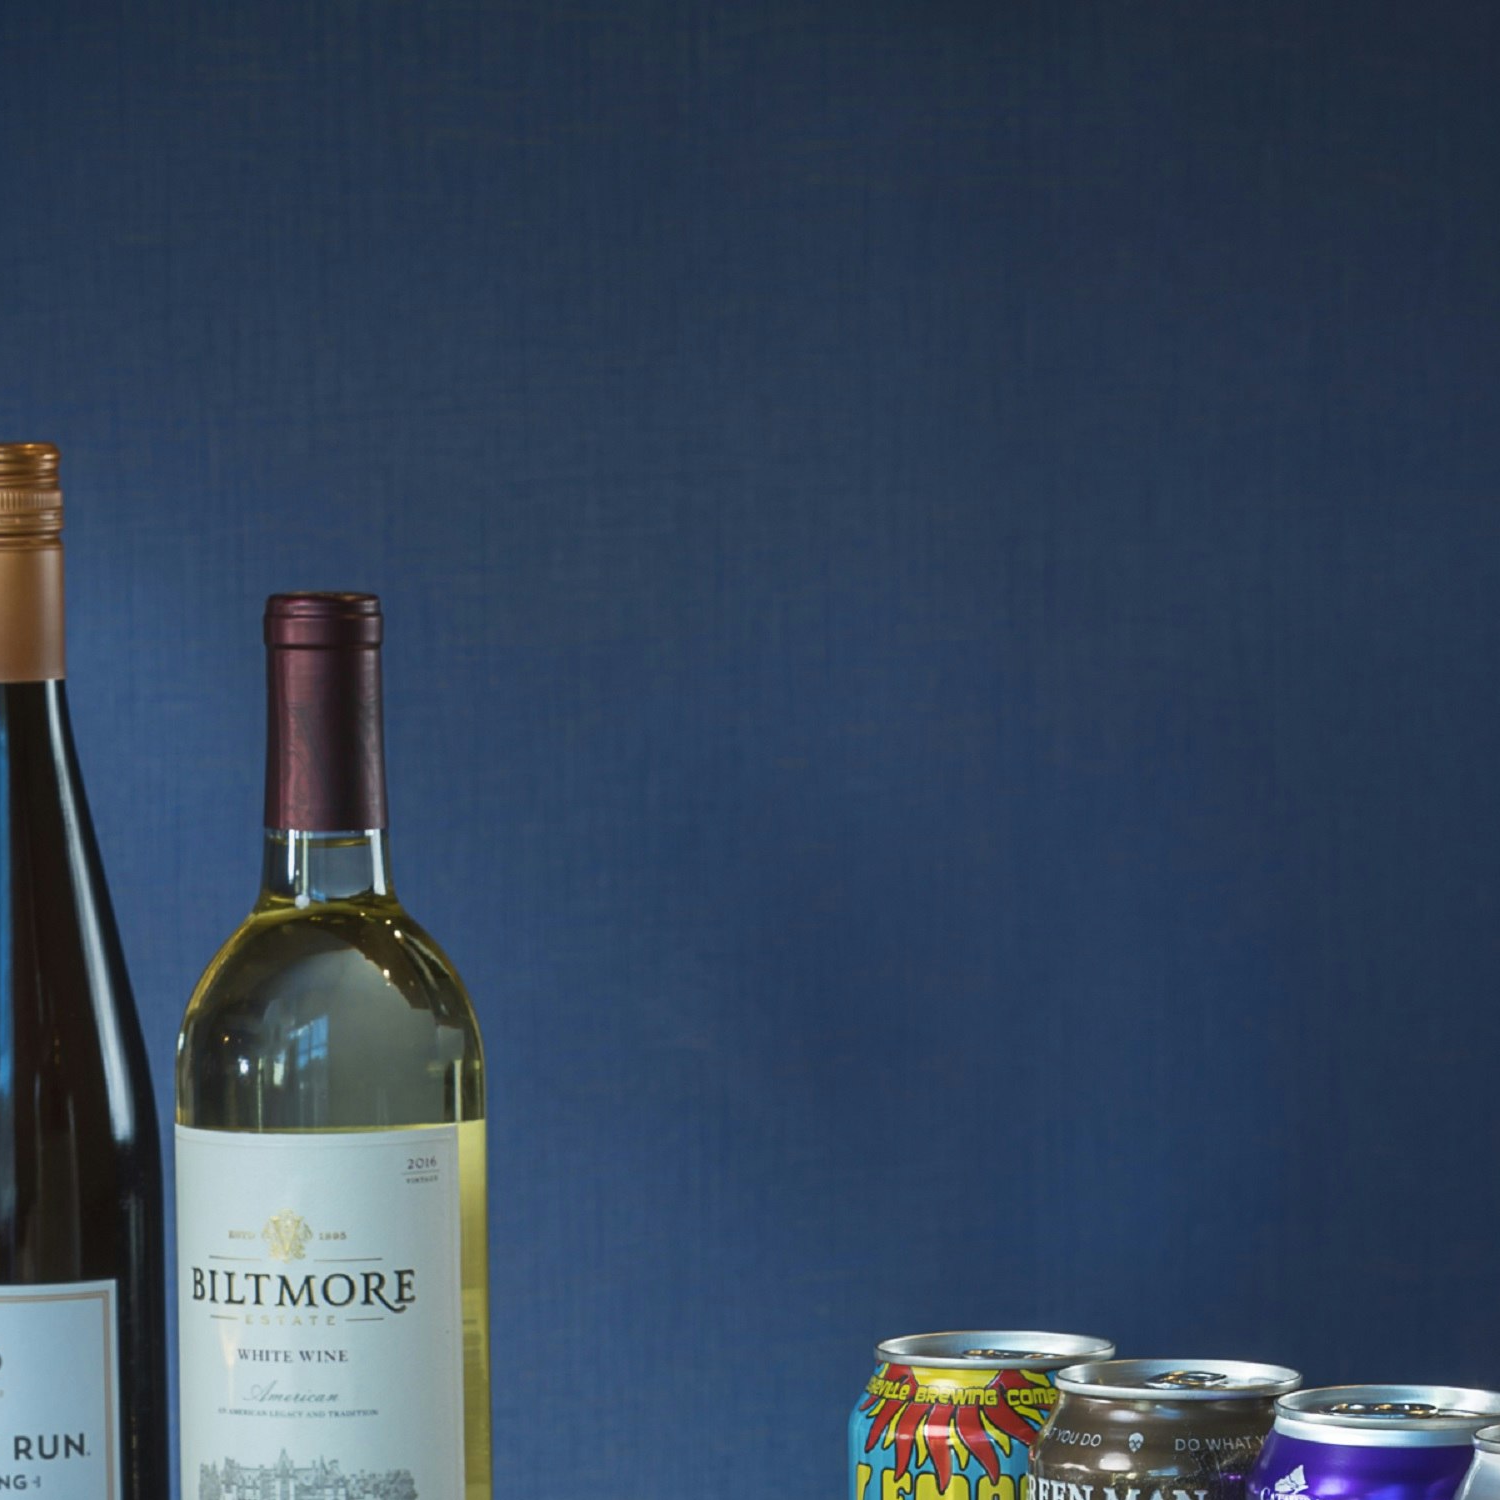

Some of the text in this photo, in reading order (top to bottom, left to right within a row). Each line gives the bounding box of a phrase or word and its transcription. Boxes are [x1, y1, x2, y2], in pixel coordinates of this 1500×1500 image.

[407, 1156, 437, 1171] 2016
[191, 1266, 417, 1314] BILTMORE
[245, 1315, 336, 1326] ESTATE
[237, 1348, 349, 1363] WHITE WINE
[243, 1379, 340, 1403] American
[915, 1386, 998, 1405] BREWING
[1006, 1387, 1058, 1406] COMP
[1080, 1432, 1102, 1447] DO
[1175, 1438, 1200, 1451] DO
[1205, 1435, 1252, 1451] WHAT
